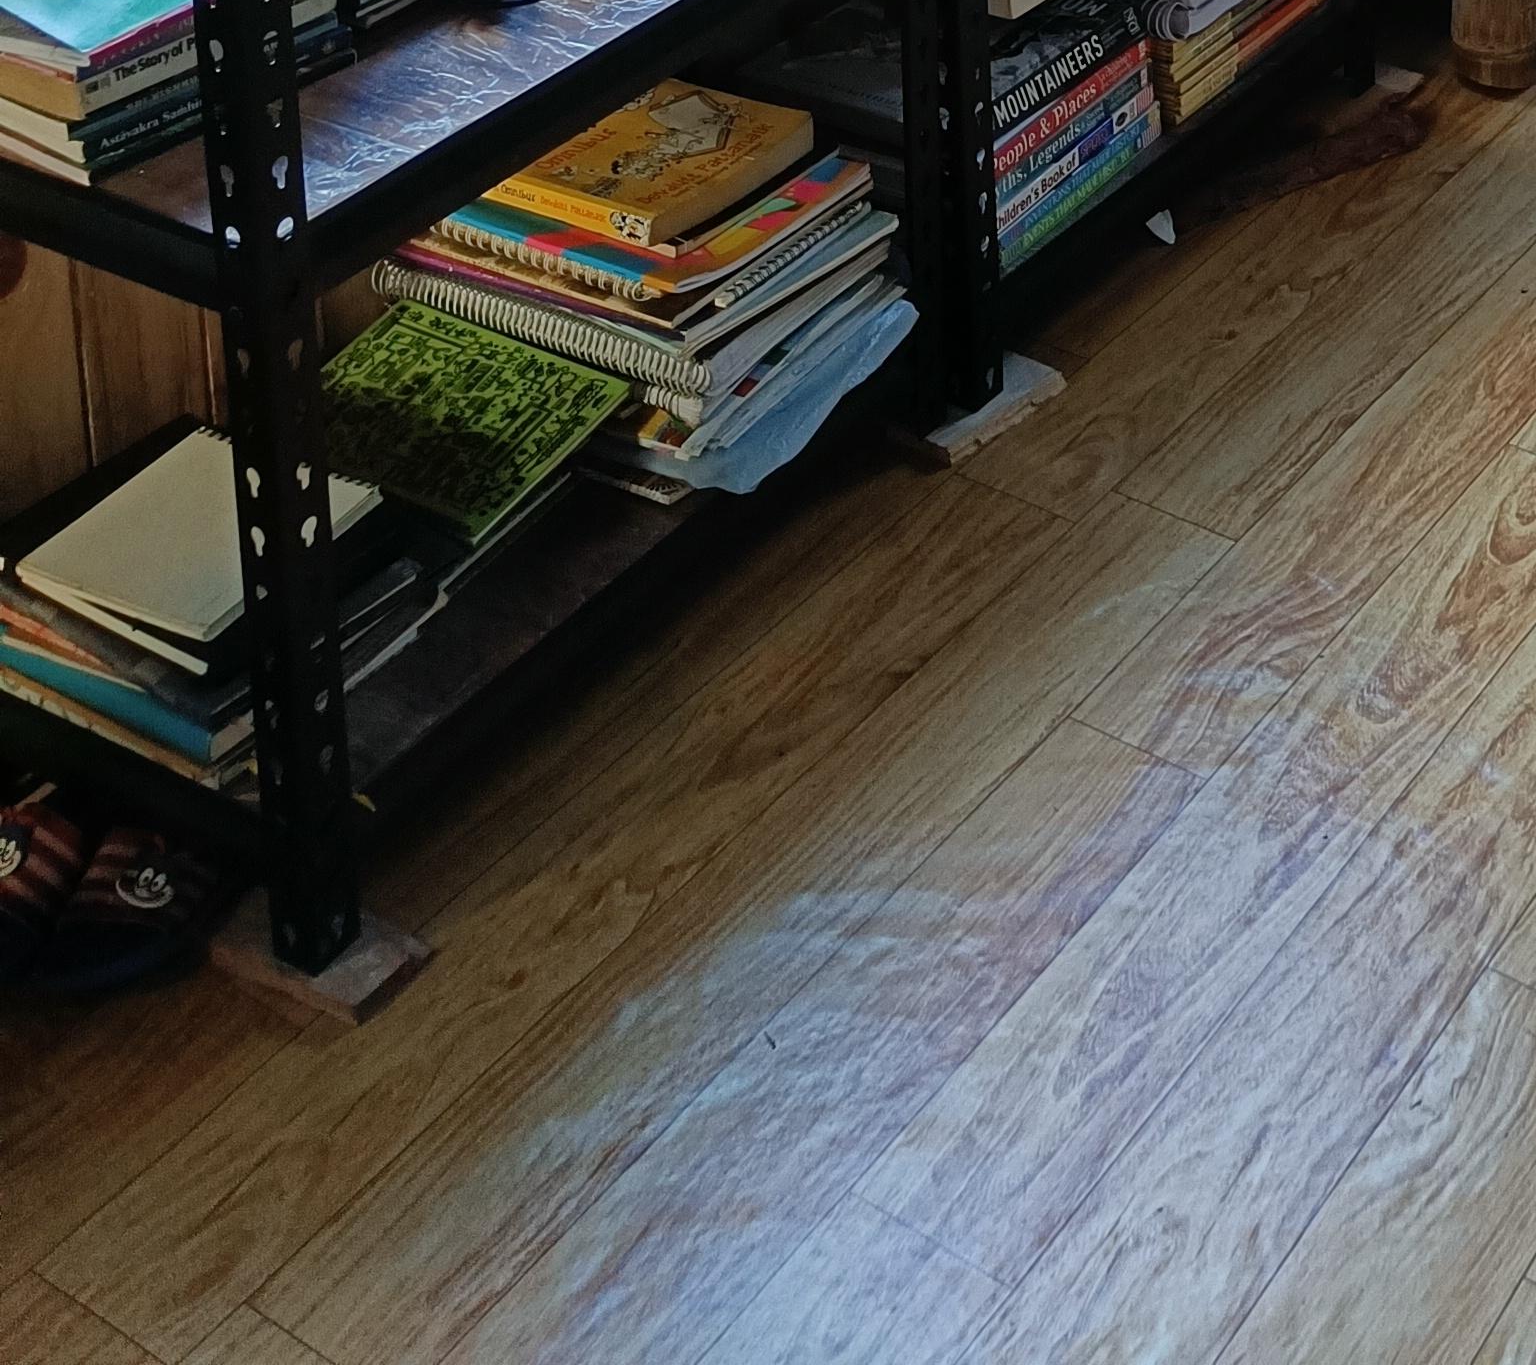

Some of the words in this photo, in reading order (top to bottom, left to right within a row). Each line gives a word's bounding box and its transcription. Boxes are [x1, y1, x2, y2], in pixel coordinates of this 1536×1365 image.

[112, 63, 137, 82] The
[137, 51, 170, 71] Story
[171, 41, 183, 57] of
[186, 36, 196, 51] P
[992, 33, 1105, 130] MOUNTAINEERS
[1122, 5, 1142, 37] DK
[1039, 119, 1052, 139] &
[1053, 82, 1097, 128] Places
[535, 127, 617, 170] Omnibus
[995, 171, 1029, 199] ths,
[1029, 127, 1081, 171] Legends
[500, 184, 536, 203] Omnibus
[998, 187, 1040, 228] hildren's
[1040, 169, 1065, 194] Book
[1063, 156, 1078, 179] of
